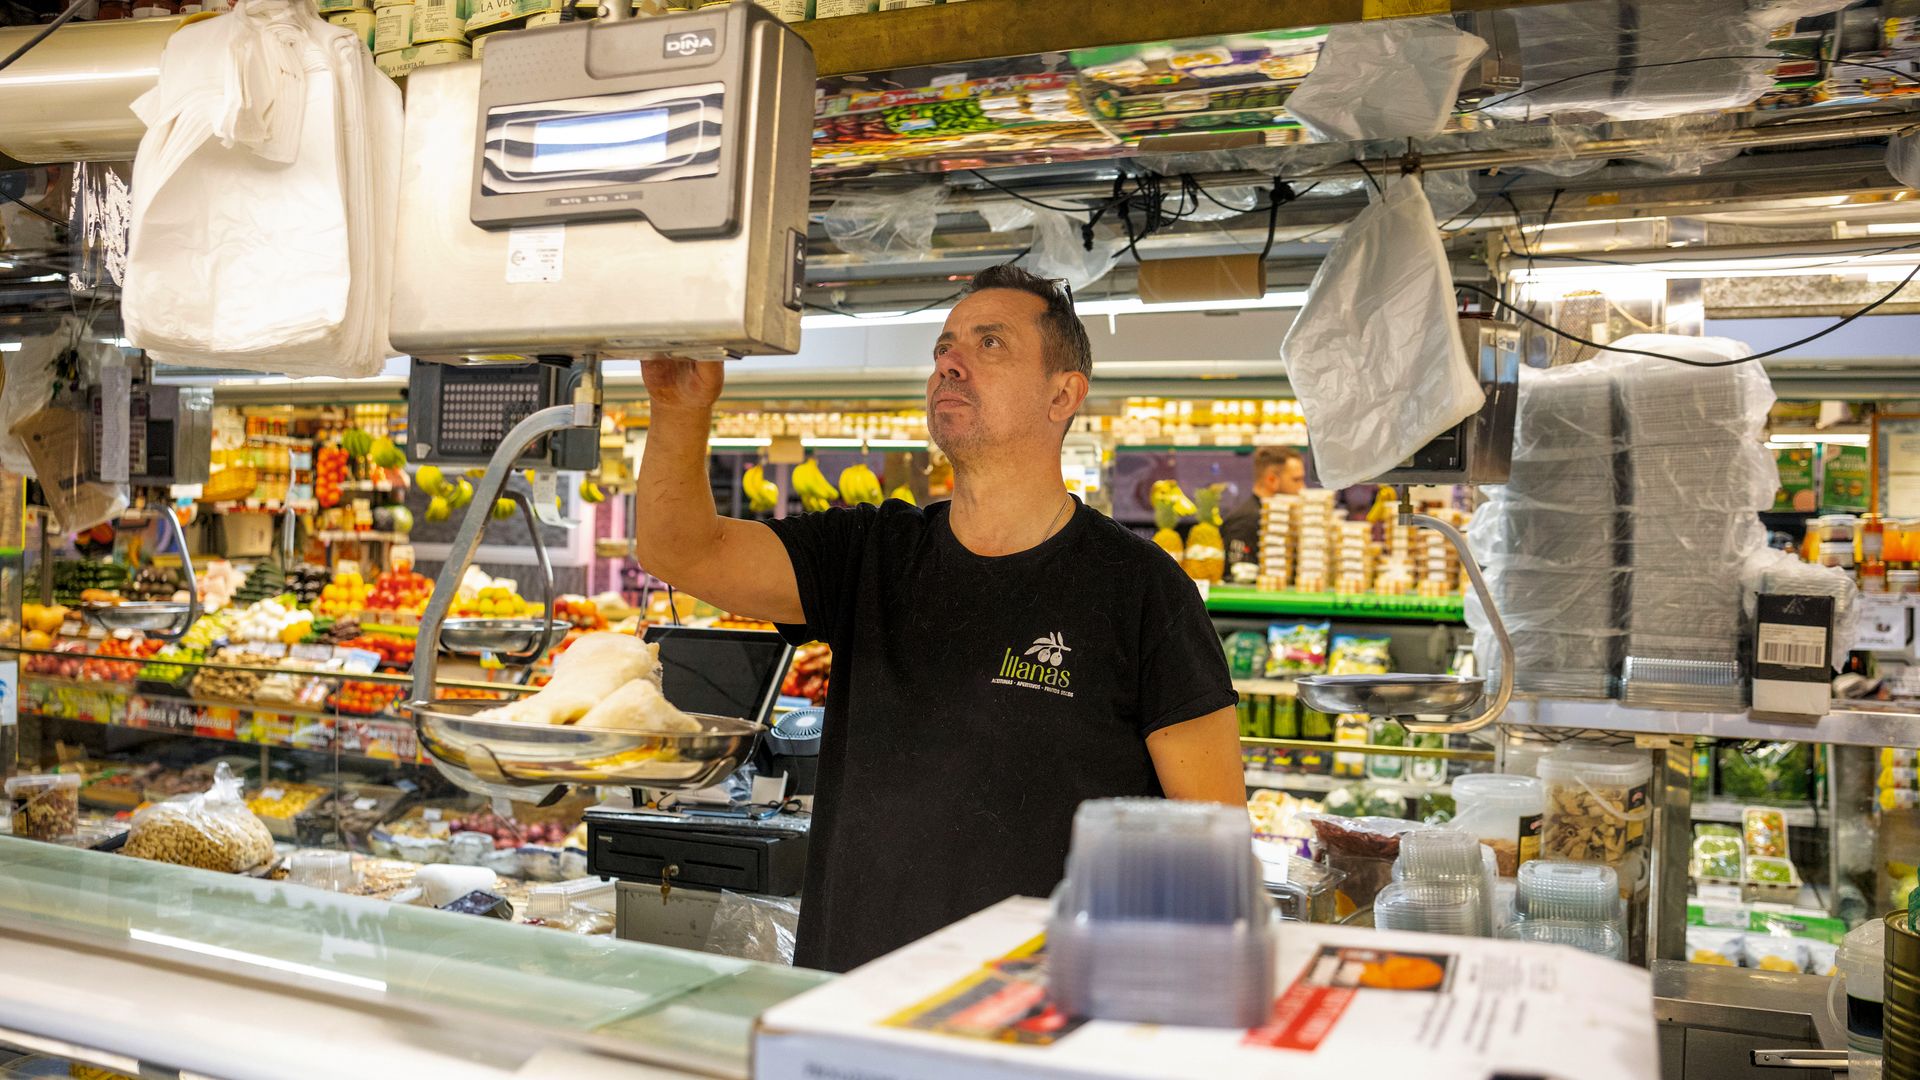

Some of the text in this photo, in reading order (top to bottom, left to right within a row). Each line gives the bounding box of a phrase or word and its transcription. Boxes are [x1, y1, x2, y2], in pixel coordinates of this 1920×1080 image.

[480, 0, 519, 13] LA VER
[388, 65, 396, 73] LA
[397, 62, 418, 72] HUERTA
[1331, 598, 1354, 611] LA
[1359, 598, 1439, 613] CALIDAD
